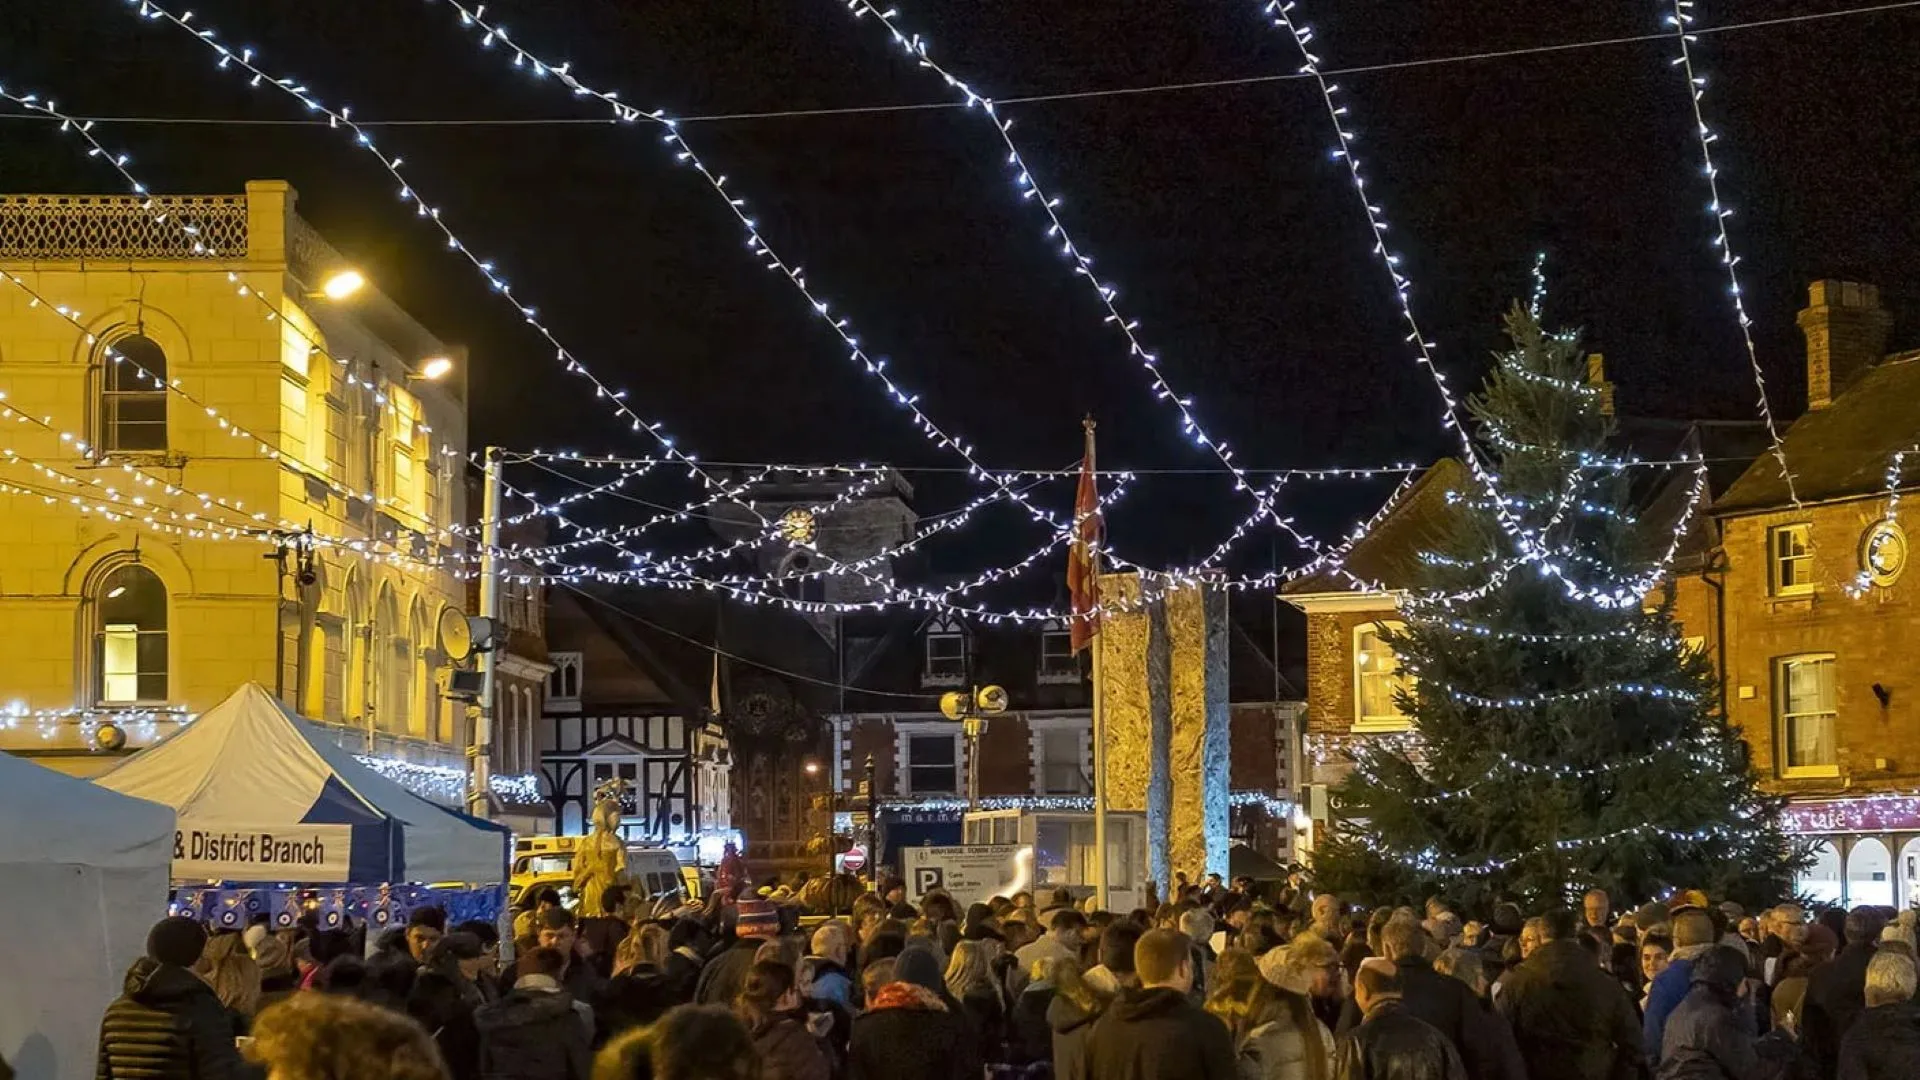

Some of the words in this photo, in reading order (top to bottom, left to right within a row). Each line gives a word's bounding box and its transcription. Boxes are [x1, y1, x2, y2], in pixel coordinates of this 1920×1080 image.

[173, 830, 185, 860] &
[191, 831, 256, 862] District
[259, 833, 324, 865] Branch
[920, 870, 938, 893] P
